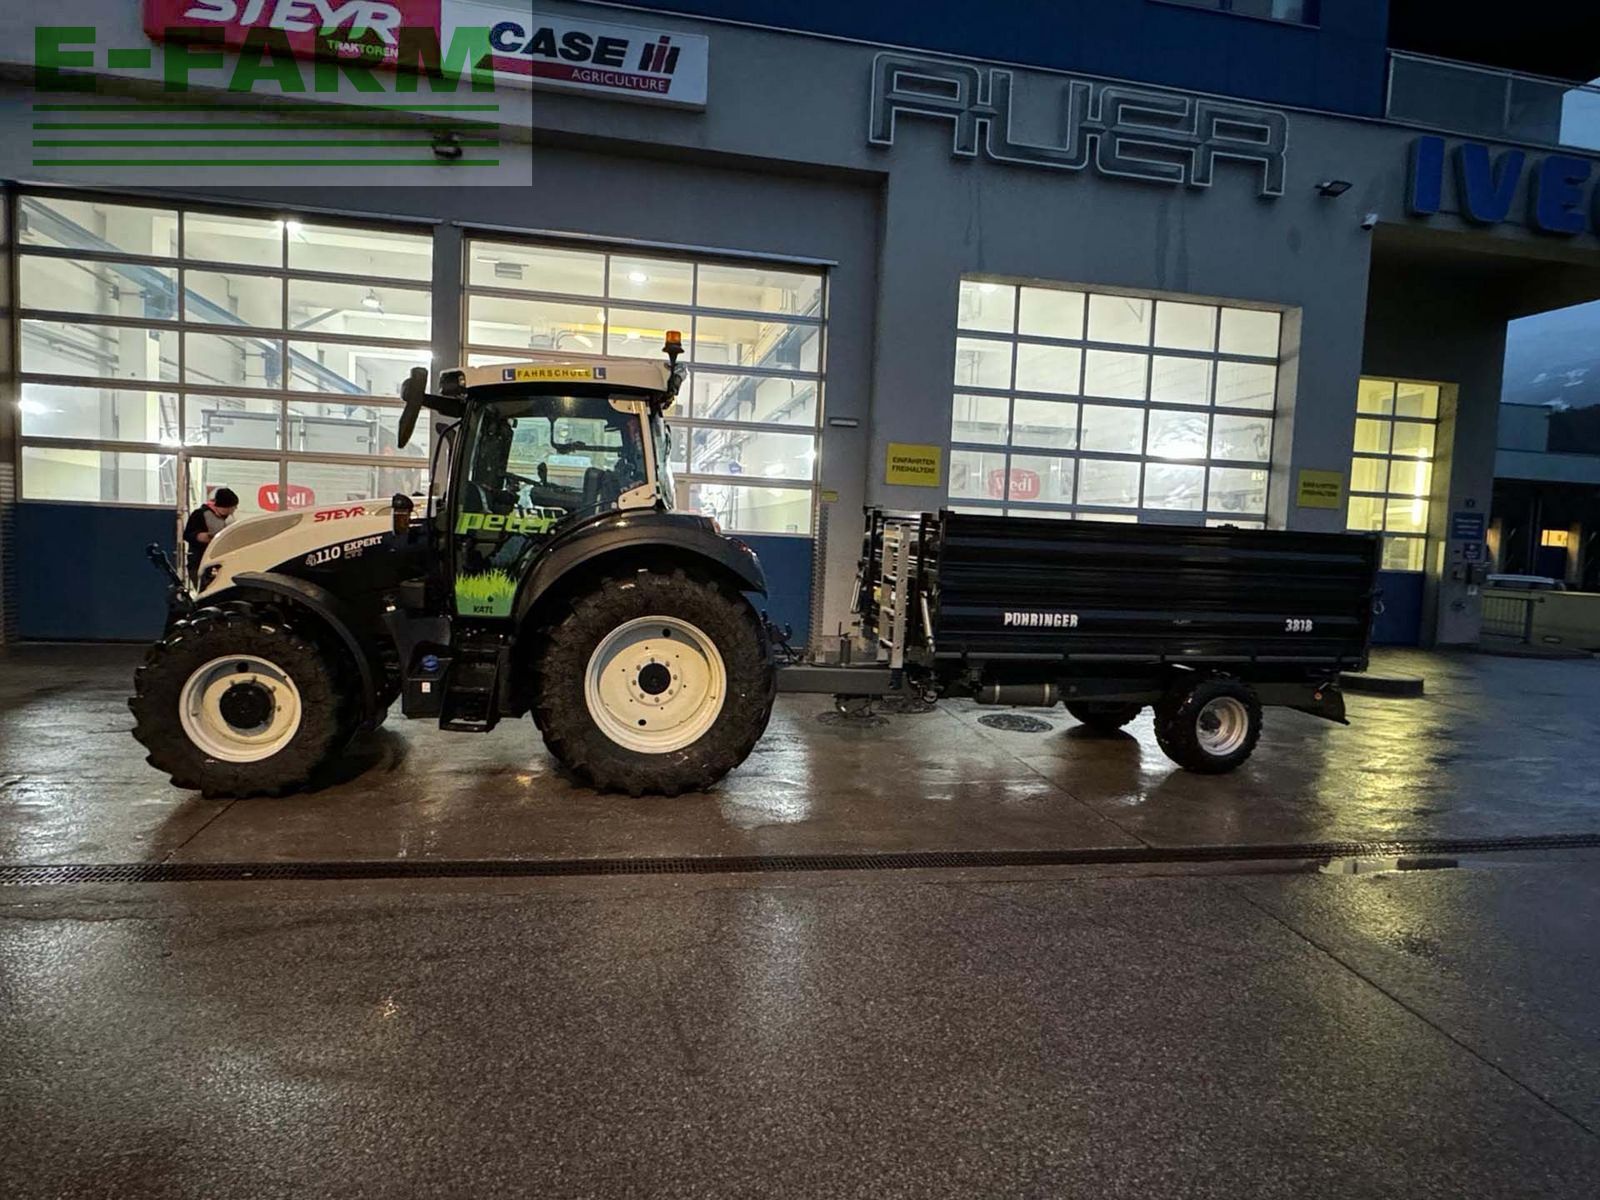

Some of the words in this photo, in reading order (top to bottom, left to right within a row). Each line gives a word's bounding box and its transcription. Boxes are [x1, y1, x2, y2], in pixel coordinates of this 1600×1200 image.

[327, 39, 399, 58] TRAKTOREN
[489, 21, 630, 68] CASE
[571, 68, 667, 92] AGRICULTURE
[868, 50, 1290, 199] AUER
[1406, 134, 1600, 236] IVE
[504, 369, 514, 380] L
[517, 368, 592, 379] FAHRSCHULE
[595, 368, 605, 379] L
[266, 491, 306, 506] Wdl
[314, 506, 366, 522] STEYR
[343, 535, 383, 552] EXPERT
